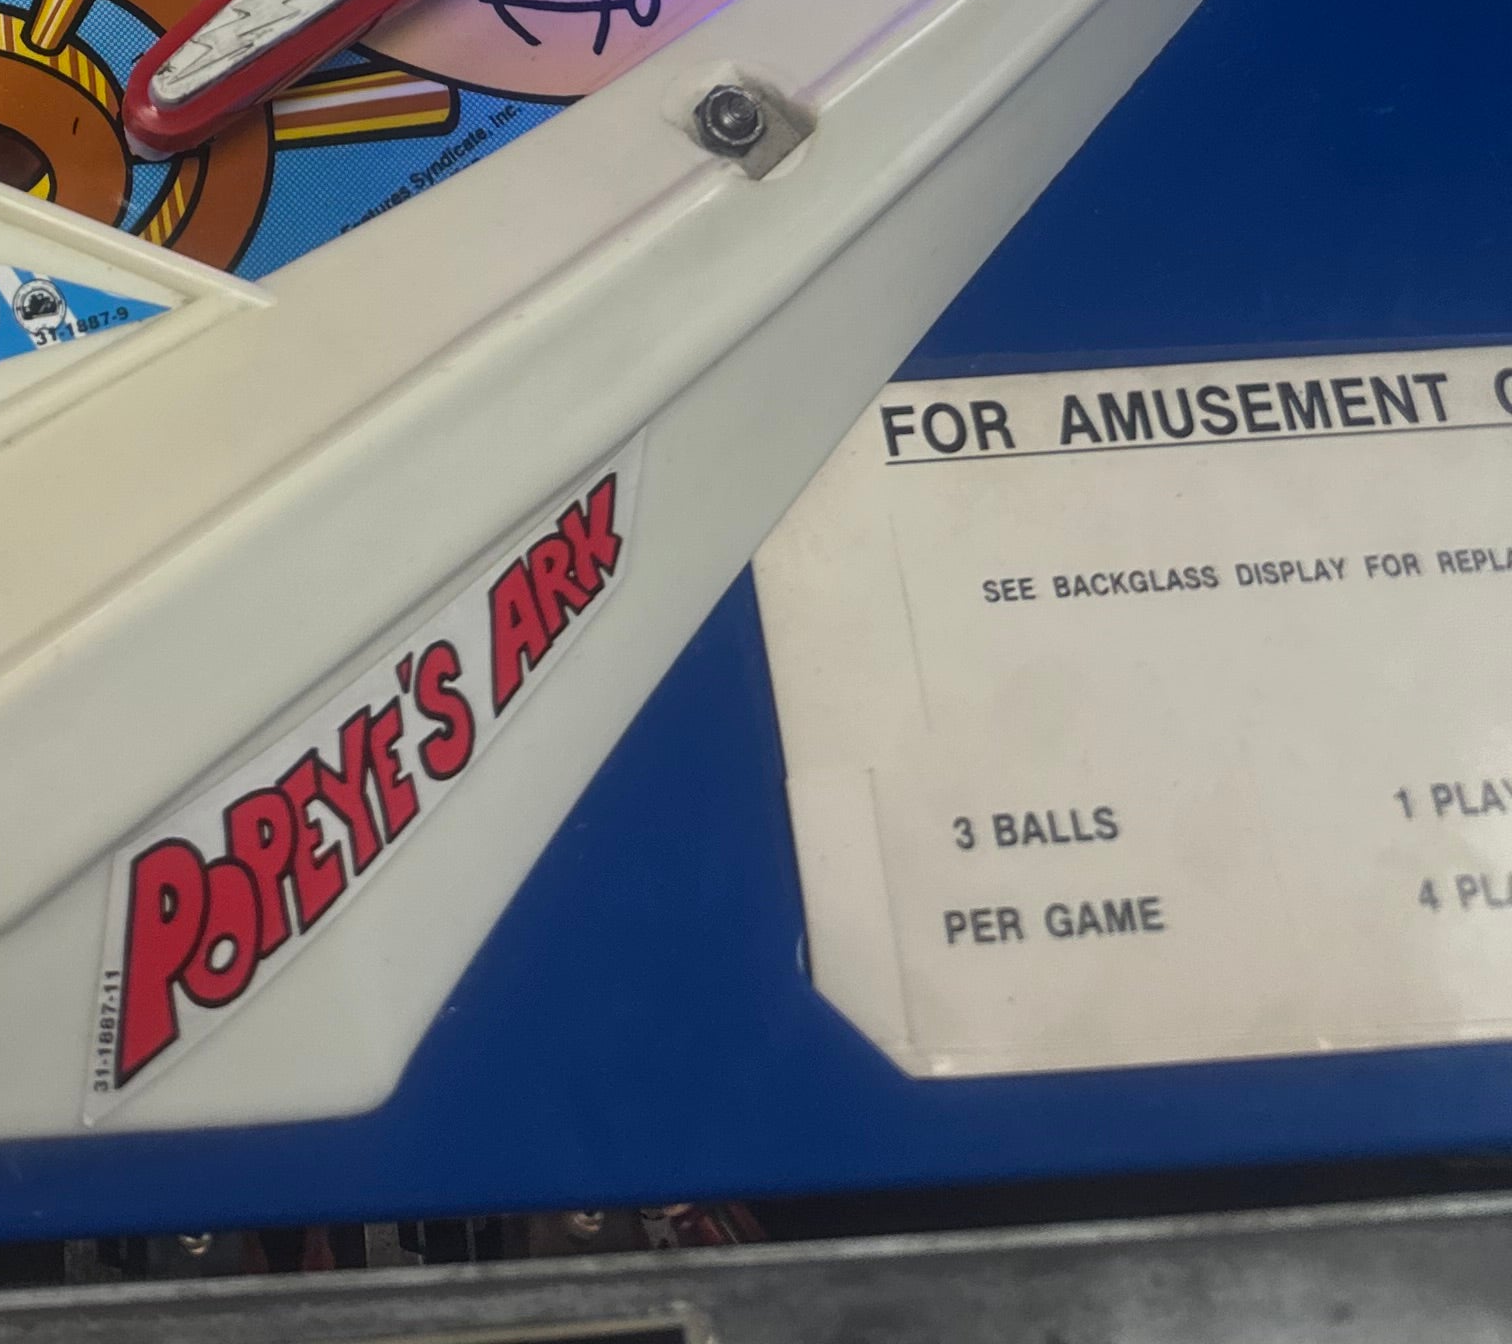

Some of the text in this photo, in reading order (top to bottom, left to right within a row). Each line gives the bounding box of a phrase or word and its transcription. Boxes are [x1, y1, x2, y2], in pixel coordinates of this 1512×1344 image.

[881, 399, 1017, 457] FOR
[1058, 372, 1451, 446] AMUSEMENT
[982, 576, 1037, 604] SEE
[1053, 565, 1220, 599] BACKGLASS
[1235, 556, 1347, 587] DISPLAY
[1363, 551, 1423, 580] FOR
[114, 470, 625, 1090] POPEYE'S ARK
[952, 786, 1414, 850] 3 BALLS 1
[943, 894, 1165, 945] PER GAME
[1417, 876, 1441, 914] 4
[92, 967, 121, 1093] 31-1887-11
